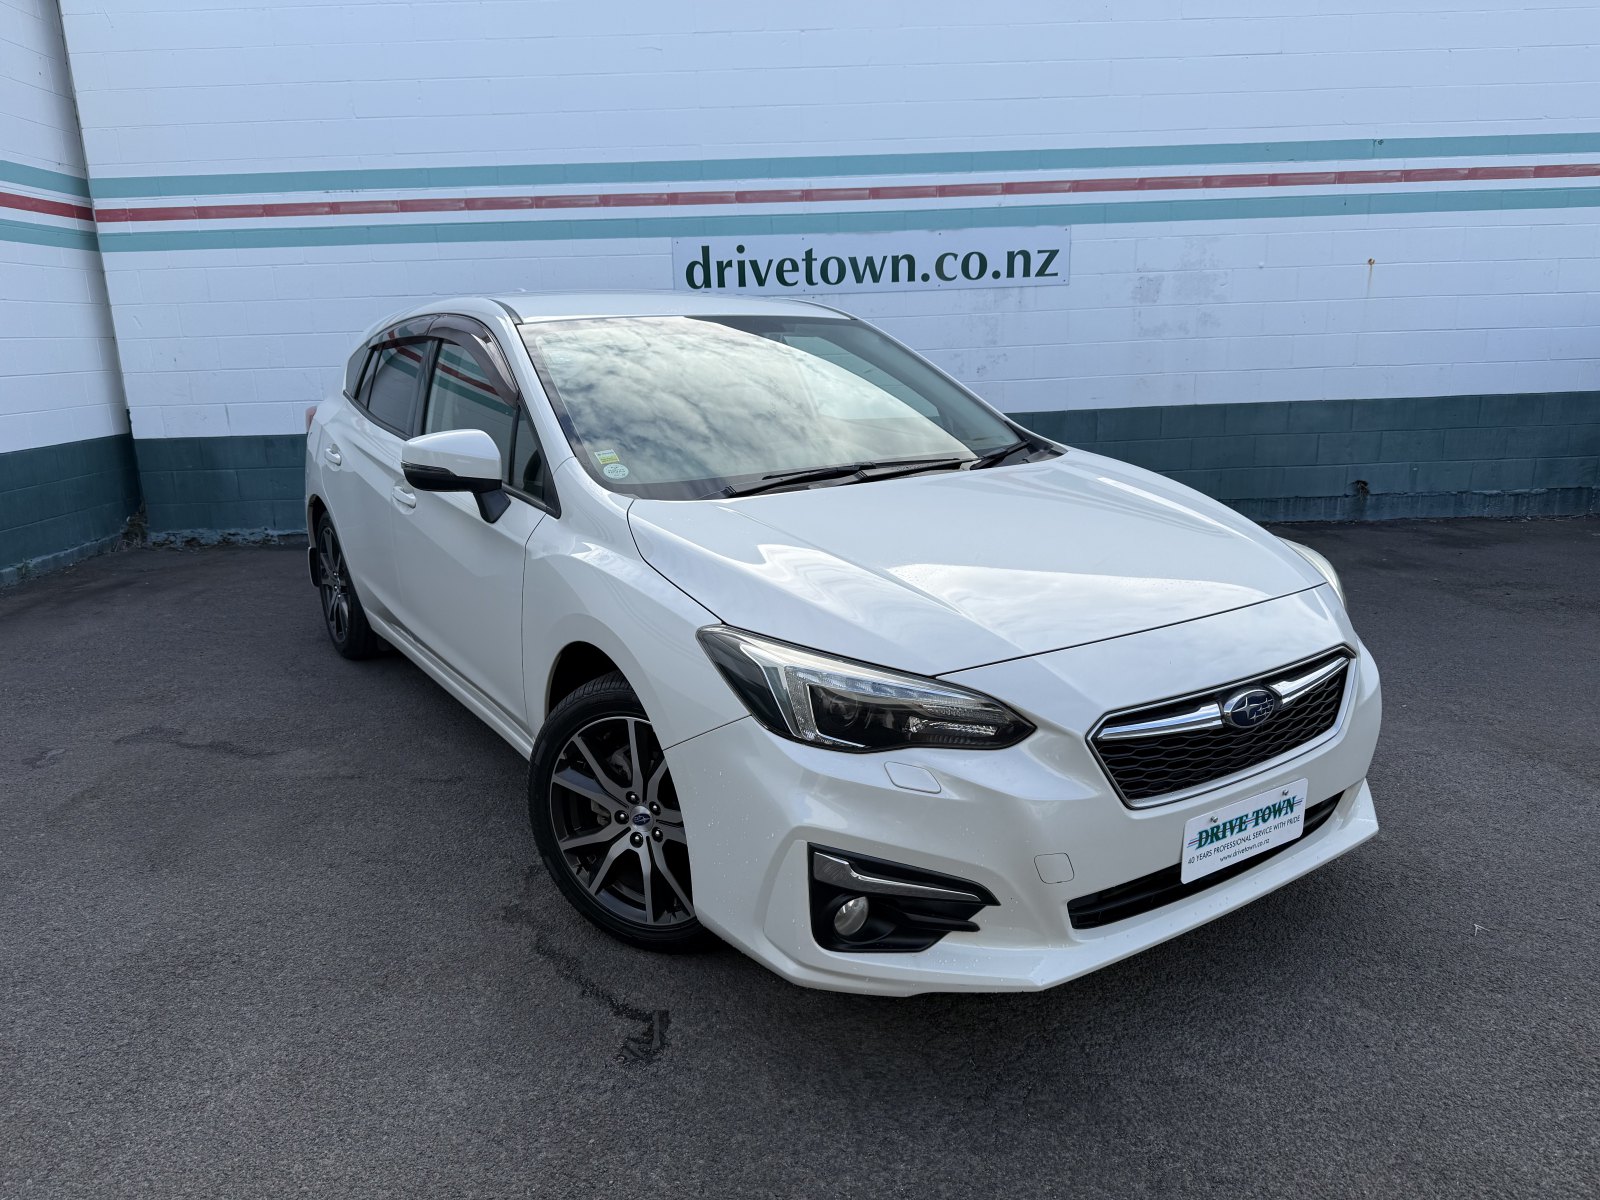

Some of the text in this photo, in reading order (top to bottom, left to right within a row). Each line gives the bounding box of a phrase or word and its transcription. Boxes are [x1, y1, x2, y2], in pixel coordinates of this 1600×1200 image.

[685, 244, 1060, 290] drivetown.co.nz
[1187, 815, 1301, 865] 40 YEARS PROFESSIONAL SERVICE WITH PRIDE
[1195, 795, 1297, 850] DRIVE TOWN
[1219, 838, 1270, 862] www.drivetown.co.nz
